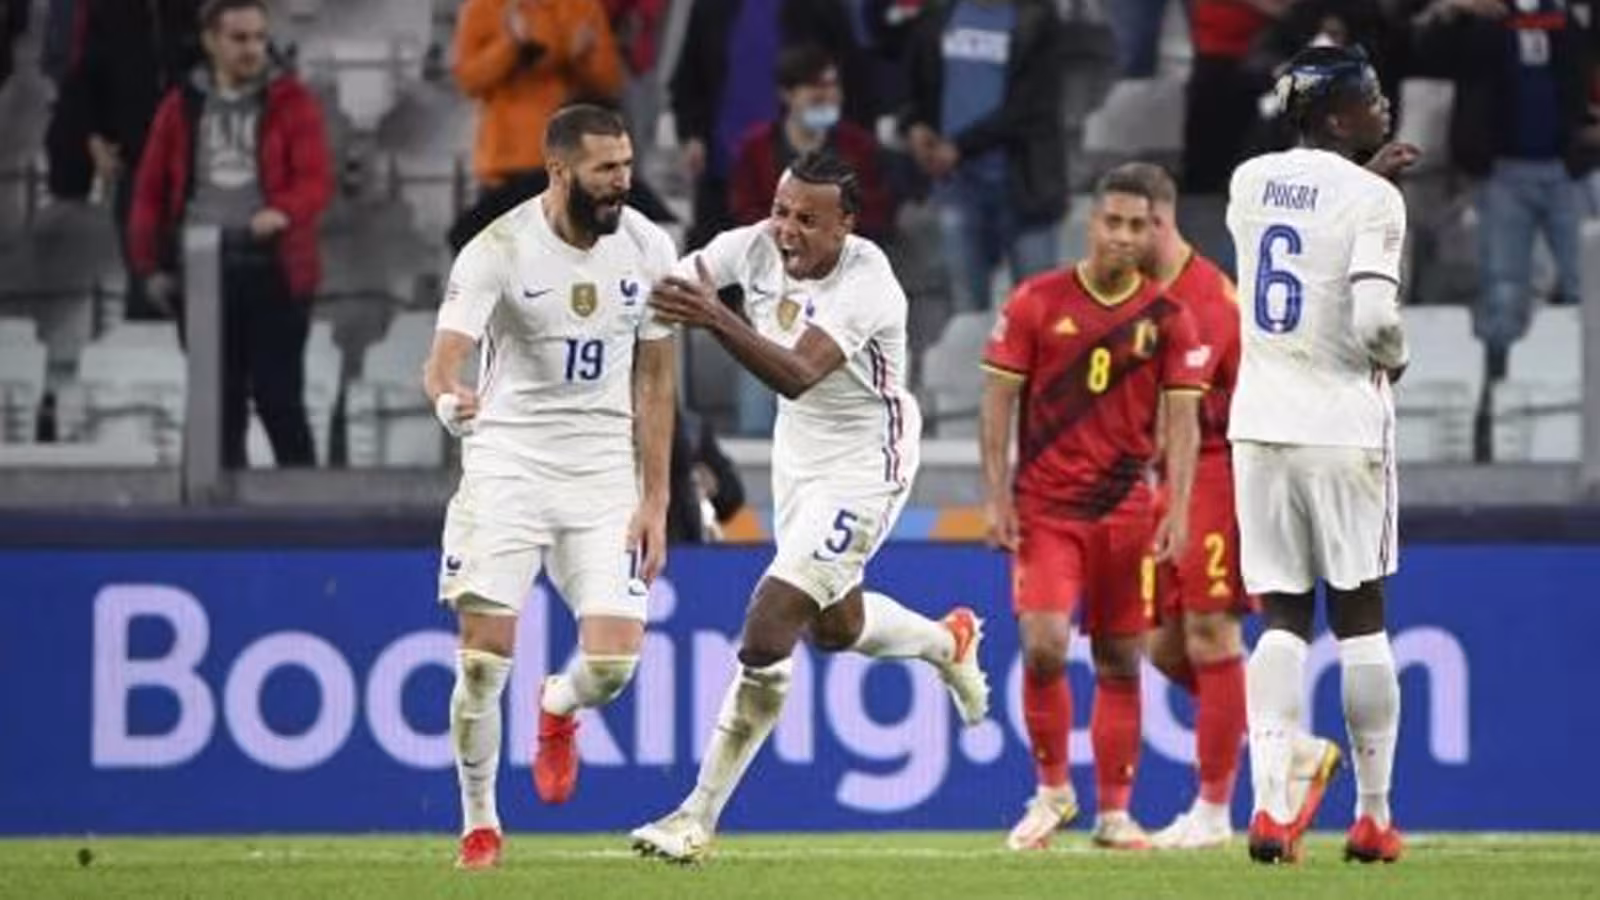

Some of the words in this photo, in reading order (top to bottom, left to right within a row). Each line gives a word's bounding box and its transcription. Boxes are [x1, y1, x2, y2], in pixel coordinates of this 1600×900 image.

[1262, 179, 1319, 211] POGBA
[1254, 224, 1303, 334] 6
[565, 338, 605, 381] 19
[1087, 346, 1112, 393] 8
[824, 508, 858, 554] 5
[1203, 531, 1228, 577] 2
